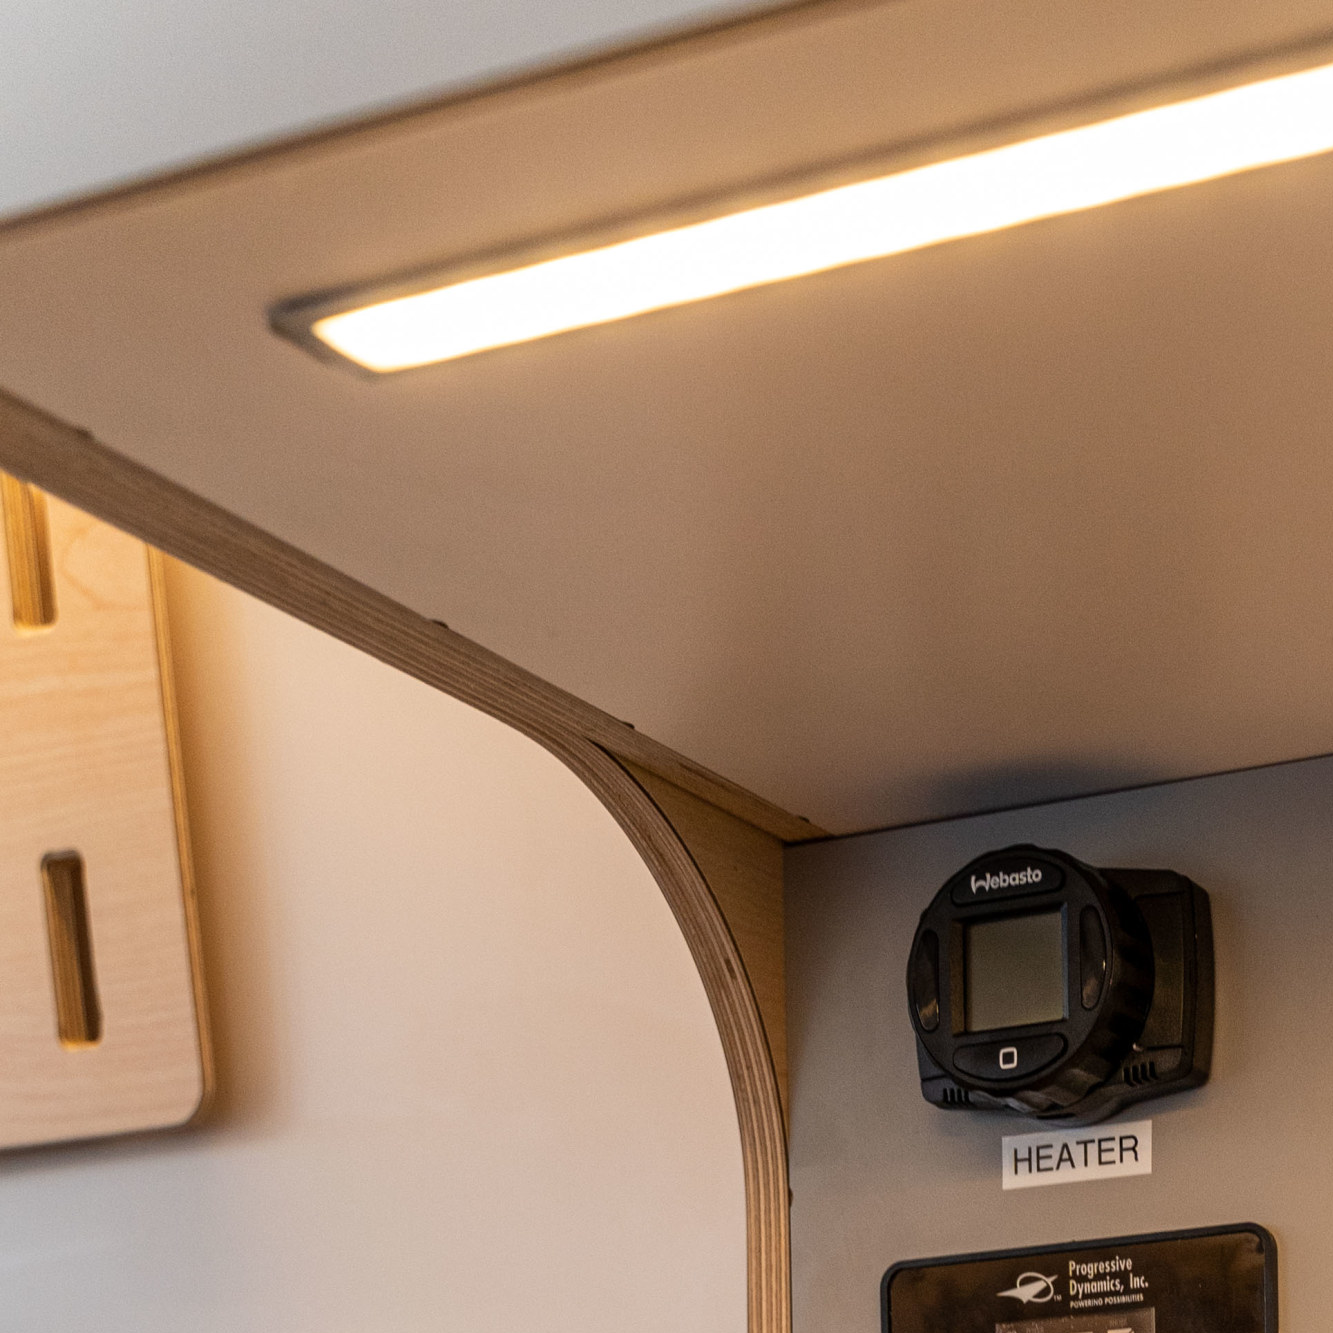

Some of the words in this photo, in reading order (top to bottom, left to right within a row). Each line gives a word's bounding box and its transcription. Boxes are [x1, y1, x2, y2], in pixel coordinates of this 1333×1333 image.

[970, 866, 1042, 895] Webasto
[1013, 1134, 1139, 1175] HEATER
[1068, 1255, 1133, 1279] Progressive
[1069, 1275, 1124, 1299] Dynamics,
[1130, 1272, 1149, 1289] Inc.
